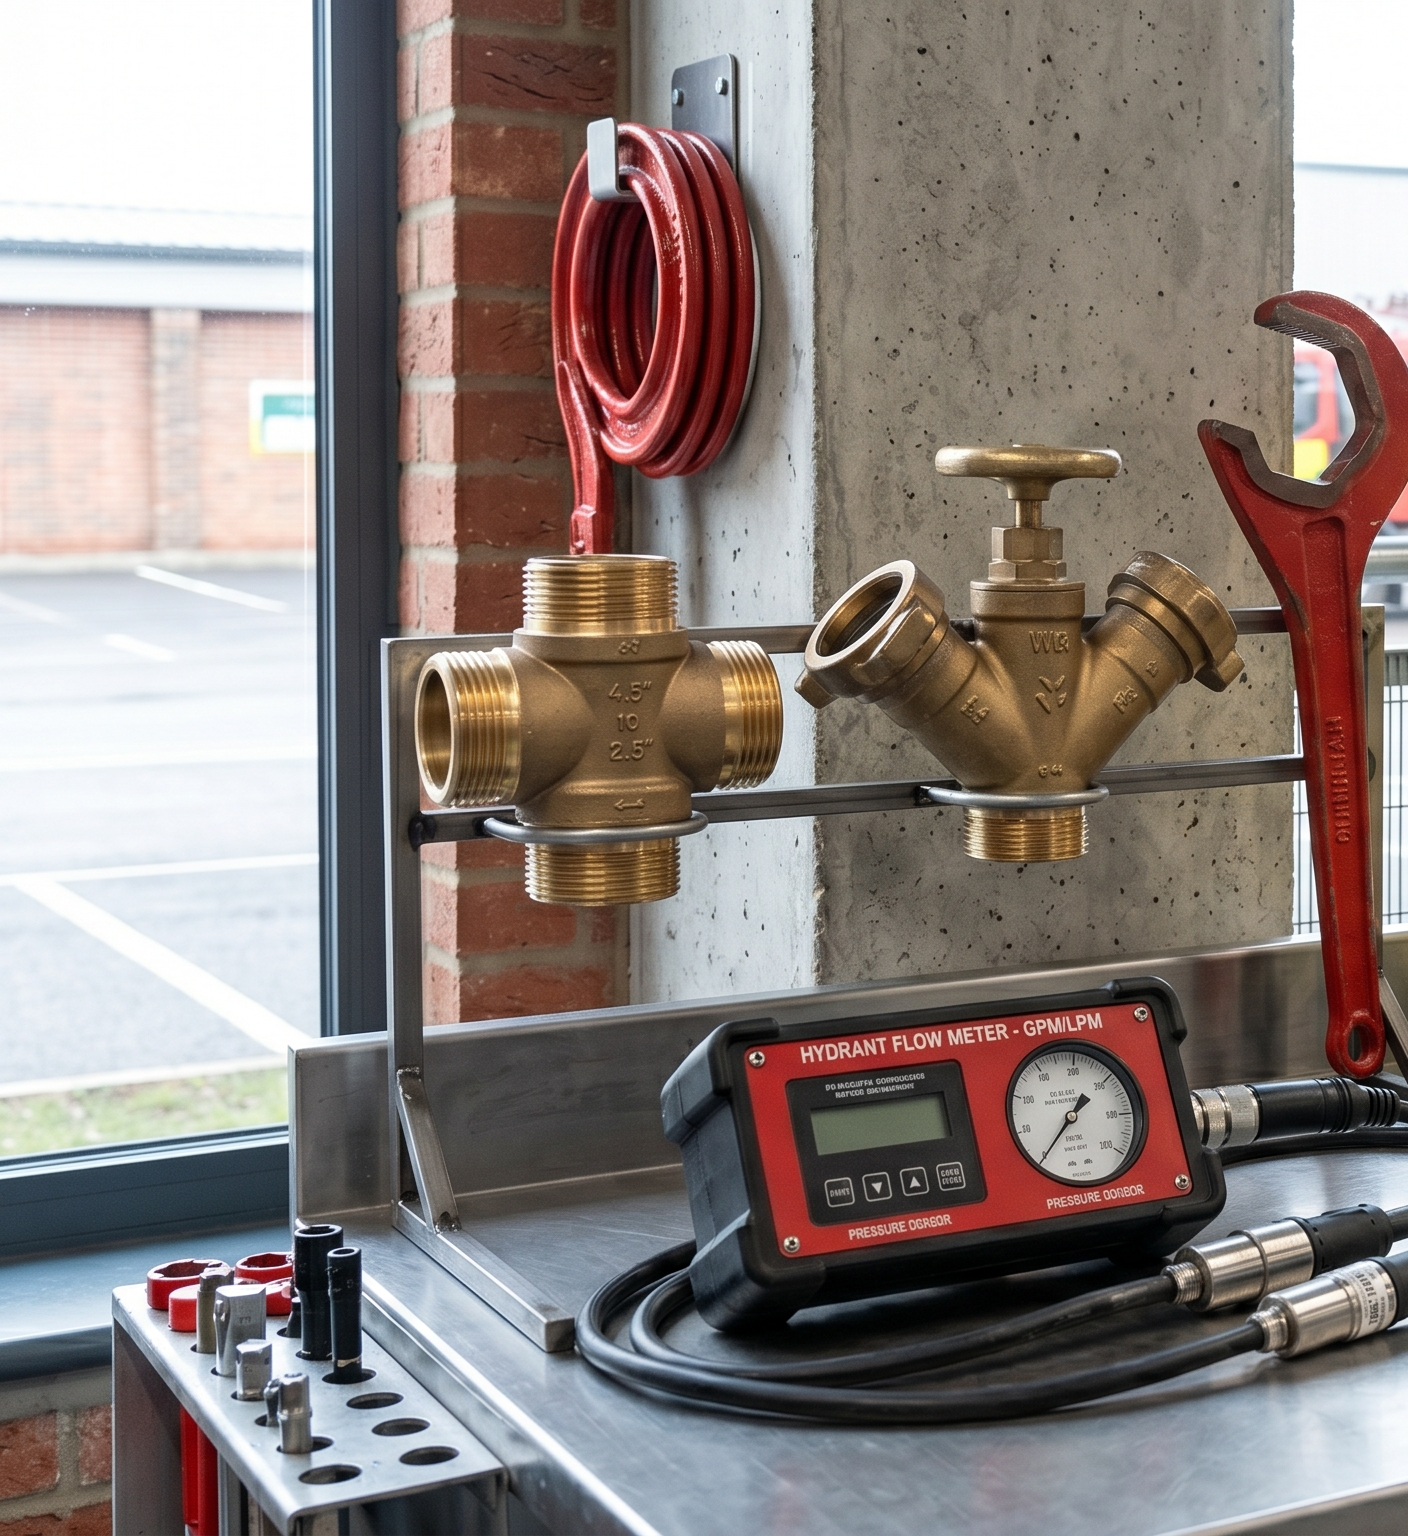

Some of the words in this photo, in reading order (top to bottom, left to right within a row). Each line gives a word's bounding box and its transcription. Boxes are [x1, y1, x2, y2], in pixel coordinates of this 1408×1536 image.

[617, 713, 639, 731] 10
[800, 1037, 887, 1064] HYDRANT
[892, 1031, 942, 1053] FLOW
[947, 1023, 1009, 1046] METER
[1023, 1012, 1103, 1037] GPM/LPM
[848, 1221, 907, 1240] PRESSURE
